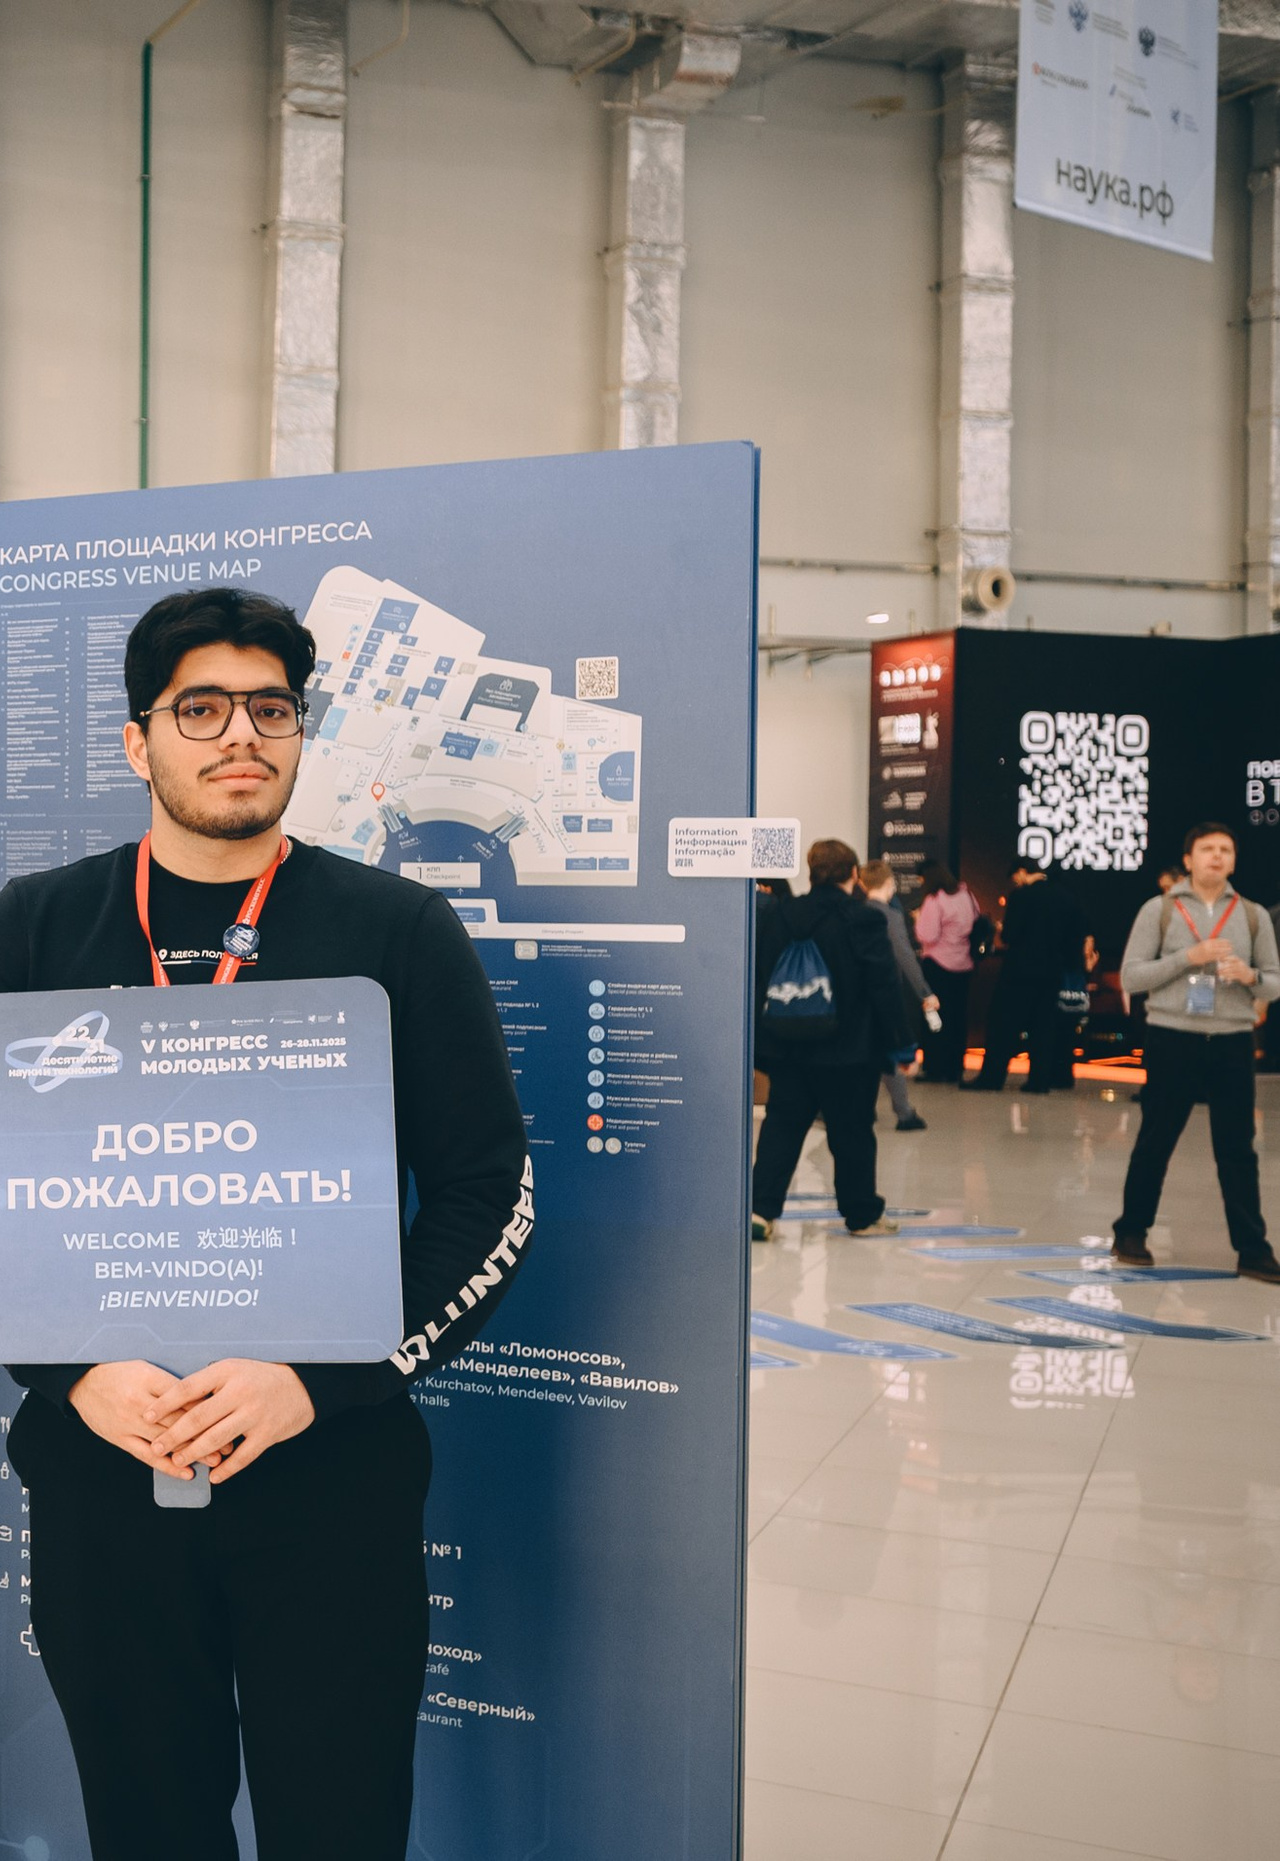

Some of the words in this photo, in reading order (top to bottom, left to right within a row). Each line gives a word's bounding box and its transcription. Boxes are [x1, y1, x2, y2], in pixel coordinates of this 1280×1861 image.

[1056, 158, 1174, 225] наука.рф
[0, 544, 70, 566] КАРТА
[75, 531, 217, 561] ПЛОЩАДКИ
[223, 520, 373, 550] КОНГРЕССА
[0, 567, 117, 594] CONGRESS
[122, 562, 201, 585] VENUE
[209, 558, 262, 579] MAP
[675, 827, 738, 836] Information
[675, 837, 748, 847] Информация
[675, 847, 736, 857] Informação
[426, 873, 461, 881] Checkpoint
[170, 950, 200, 960] ЗДЕСЬ
[141, 1039, 156, 1054] V
[161, 1034, 269, 1053] КОНГРЕСС
[8, 1067, 42, 1079] науки
[52, 1064, 118, 1076] технологий
[41, 1055, 118, 1066] десятилетие
[141, 1057, 252, 1075] МОЛОДЫХ
[257, 1052, 348, 1071] УЧЕНЫХ
[92, 1119, 258, 1163] ДОБРО
[7, 1169, 352, 1210] ПОЖАЛОВАТЬ!
[63, 1231, 180, 1250] WELCOME
[95, 1259, 264, 1281] BEM-VINDO(A)!
[99, 1289, 260, 1312] ¡BIENVENIDO!
[499, 1342, 626, 1370] «Ломоносов»,
[450, 1358, 576, 1386] «Менделеев»,
[580, 1371, 679, 1395] «Вавилов»
[420, 1394, 450, 1408] halls
[425, 1376, 495, 1396] Kurchatov,
[498, 1384, 575, 1406] Mendeleev,
[578, 1394, 628, 1410] Vavilov
[432, 1542, 451, 1557] №
[455, 1546, 462, 1560] 1
[427, 1692, 535, 1721] «Северный»
